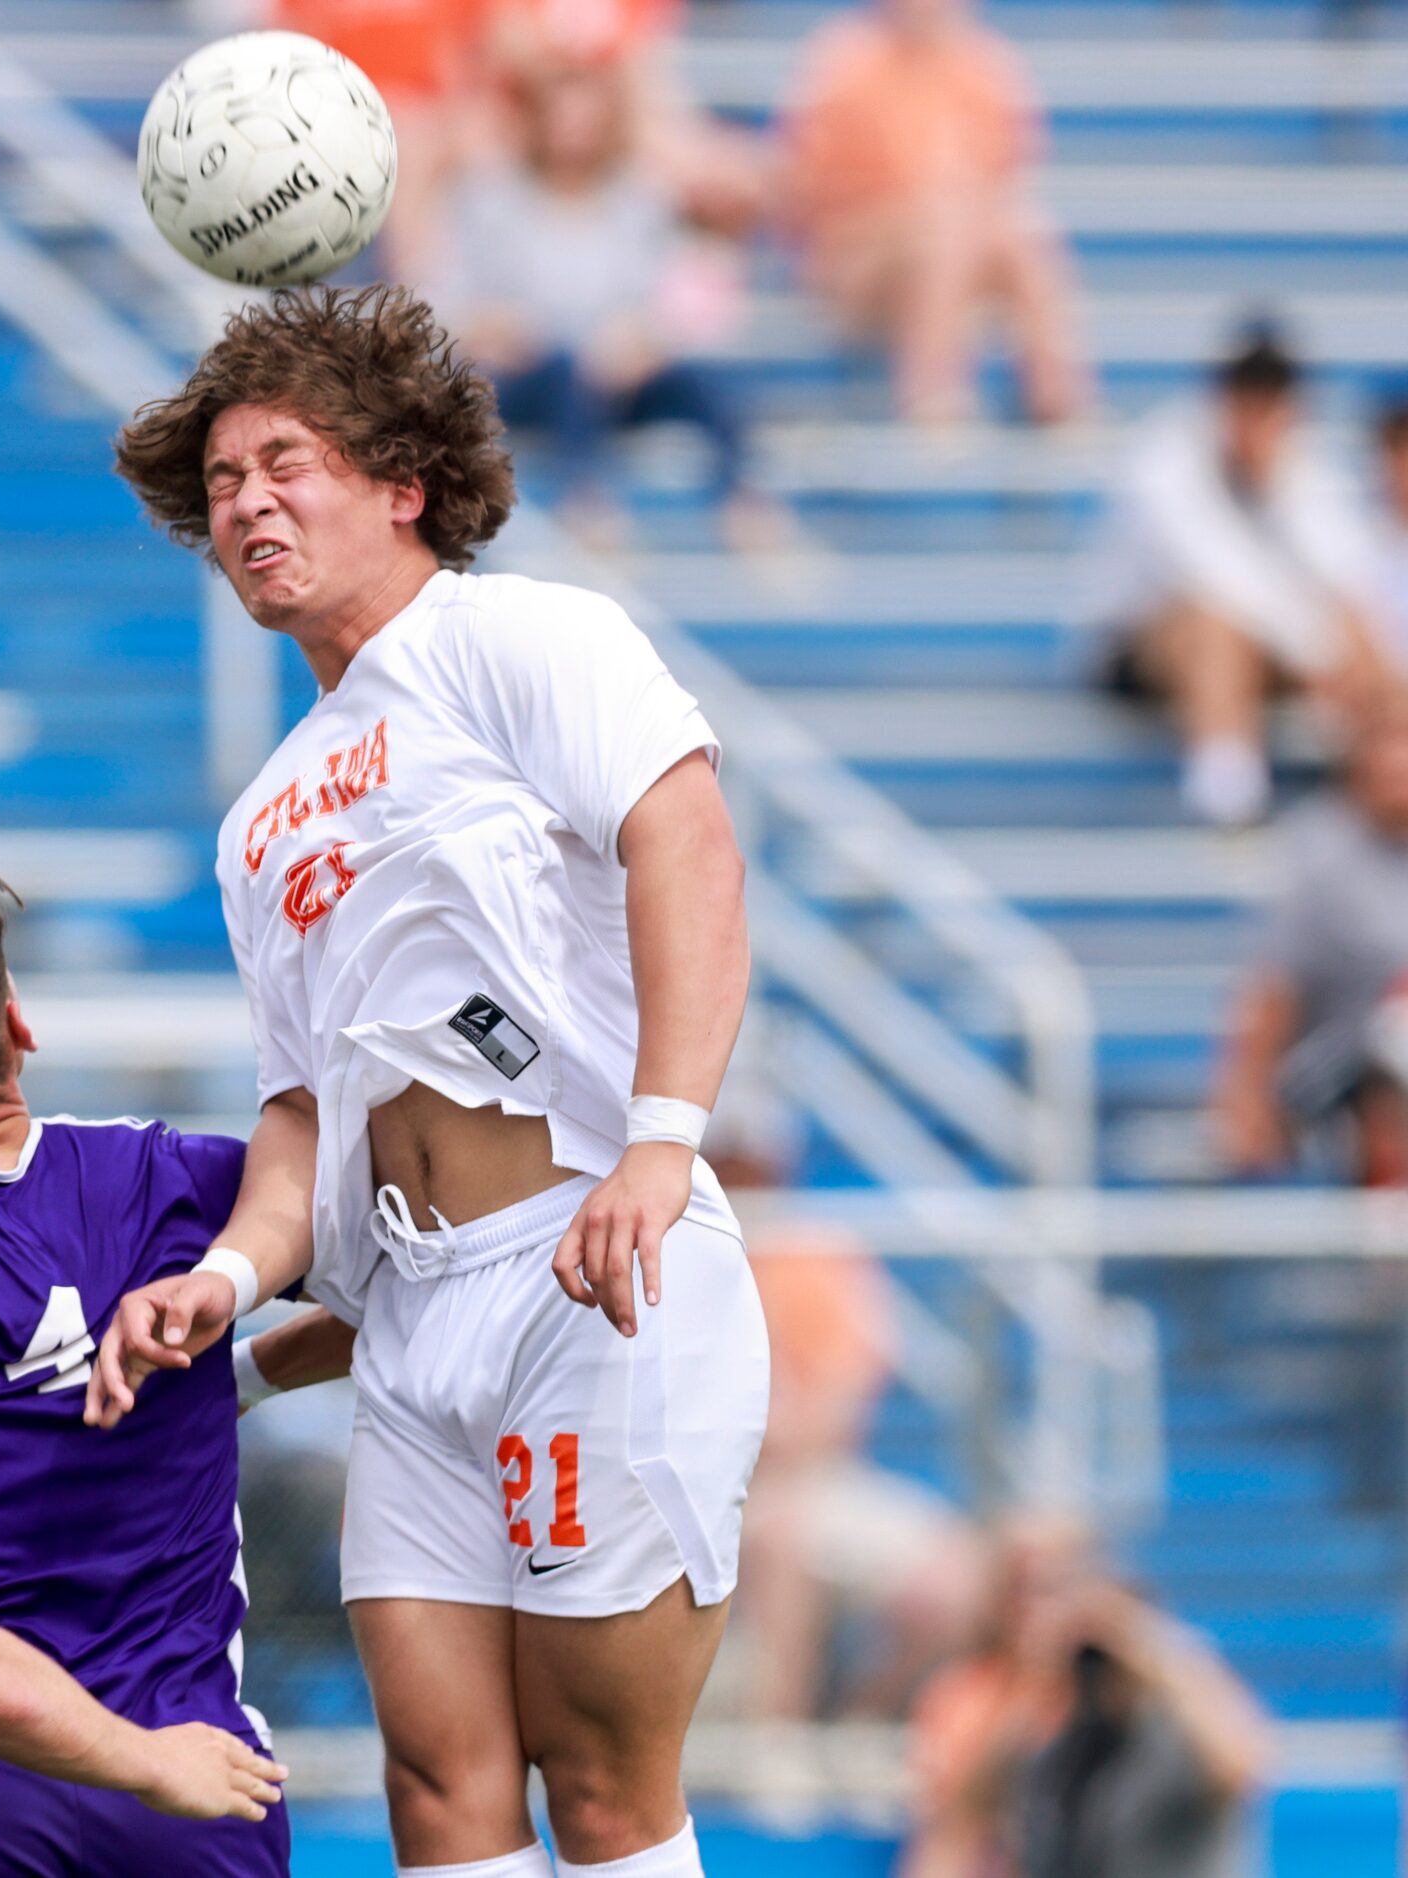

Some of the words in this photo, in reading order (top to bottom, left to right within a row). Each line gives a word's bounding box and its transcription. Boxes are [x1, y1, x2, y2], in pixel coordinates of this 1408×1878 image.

[190, 161, 320, 256] SPALDING
[495, 1049, 505, 1063] L
[4, 1285, 96, 1394] 4
[496, 1432, 586, 1547] 21
